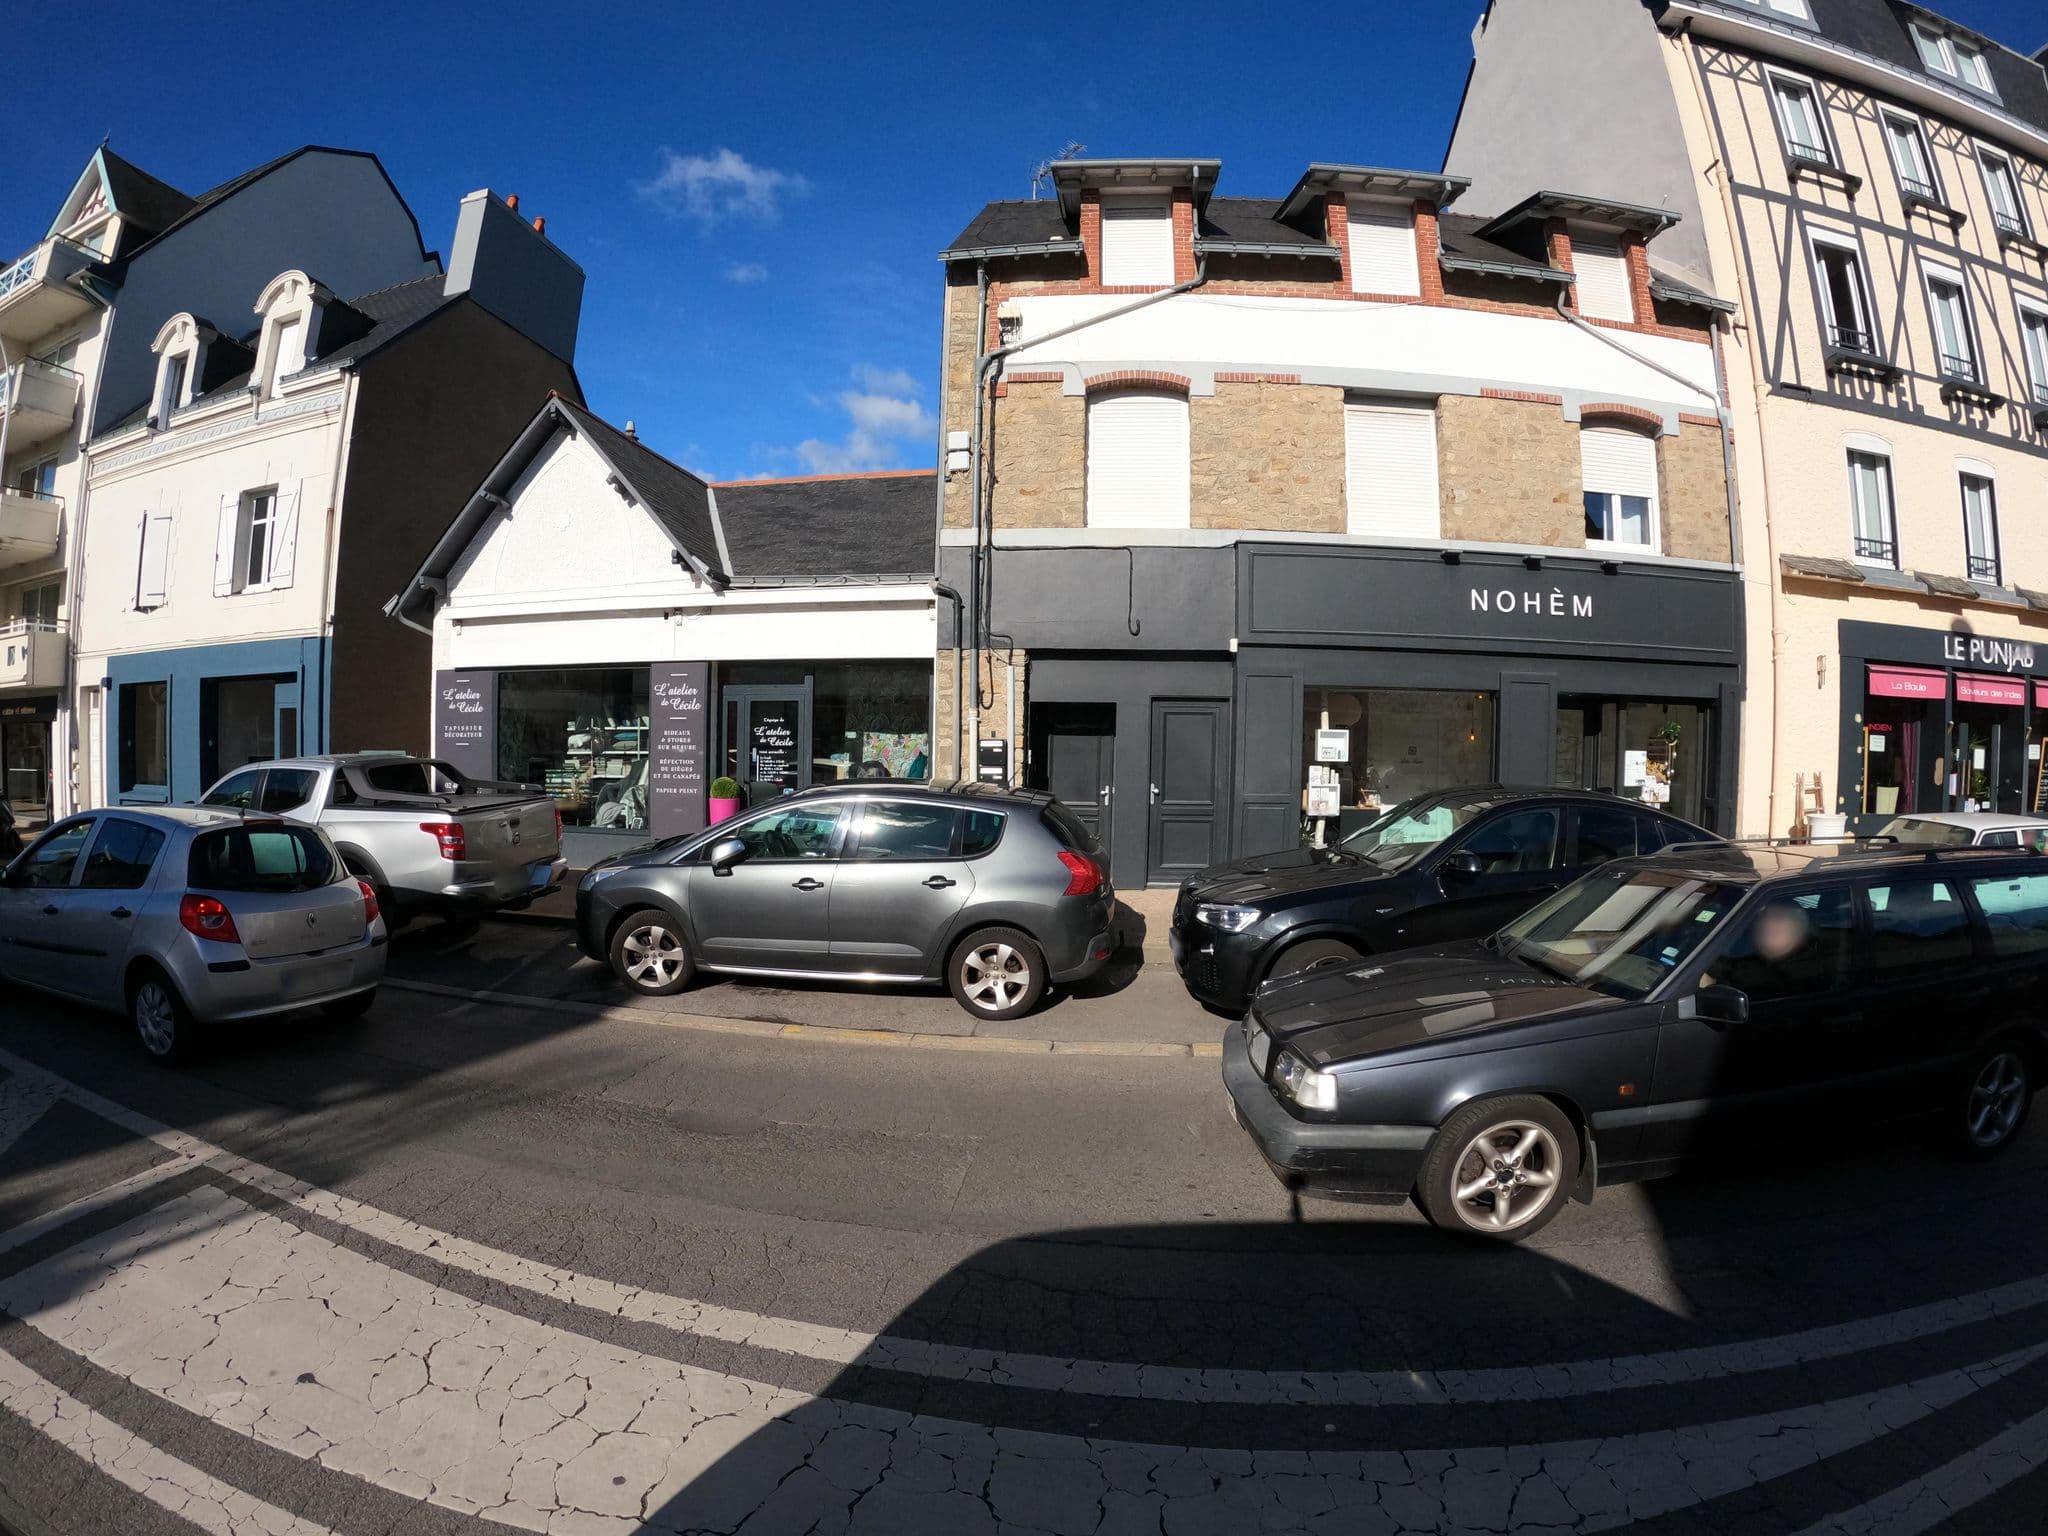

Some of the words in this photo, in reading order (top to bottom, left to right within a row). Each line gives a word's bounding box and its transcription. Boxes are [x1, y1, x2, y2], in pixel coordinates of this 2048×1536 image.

[1471, 587, 1592, 617] NOHÈM
[1944, 635, 1965, 661] LE
[654, 683, 698, 696] L'atelier
[1891, 681, 1903, 690] La
[1904, 682, 1927, 692] Baule
[1960, 686, 1989, 697] Saveurs
[442, 688, 481, 700] L'atelier
[457, 702, 484, 712] Cécile
[661, 698, 669, 706] de
[670, 698, 701, 710] Cécile
[753, 726, 791, 735] L'atelier
[767, 737, 794, 746] Cécile
